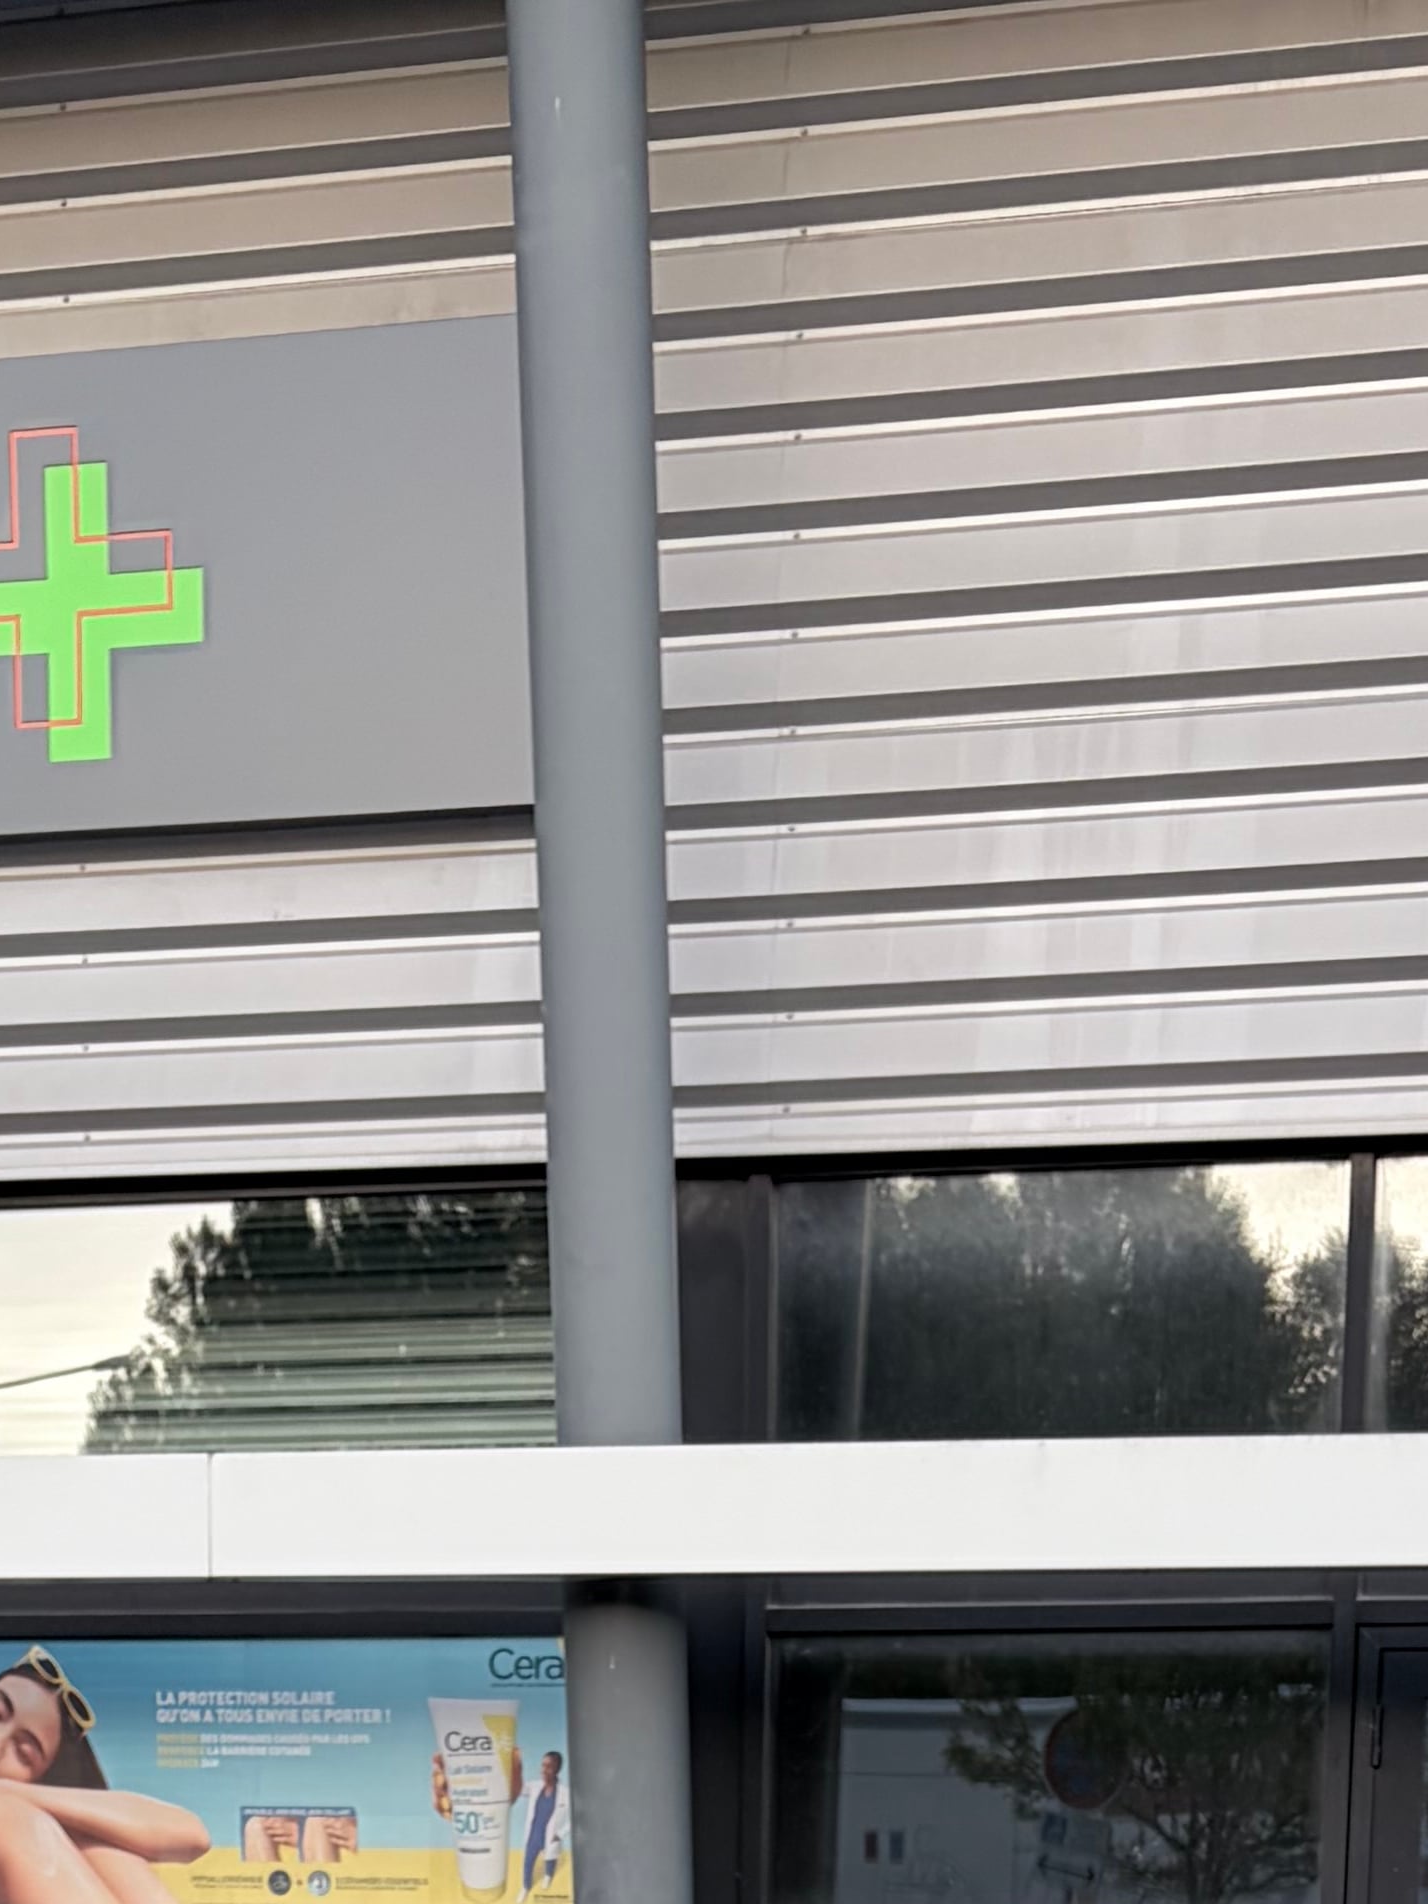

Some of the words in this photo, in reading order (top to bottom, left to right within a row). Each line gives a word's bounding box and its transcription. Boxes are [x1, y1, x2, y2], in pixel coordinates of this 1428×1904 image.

[156, 1691, 175, 1705] LA
[178, 1691, 270, 1706] PROTECTION
[272, 1691, 335, 1706] SOLAIRE
[156, 1708, 201, 1723] QU'ON
[217, 1709, 253, 1723] TOUS
[257, 1709, 298, 1723] ENVIE
[301, 1709, 321, 1723] DE
[325, 1709, 382, 1723] PORTER
